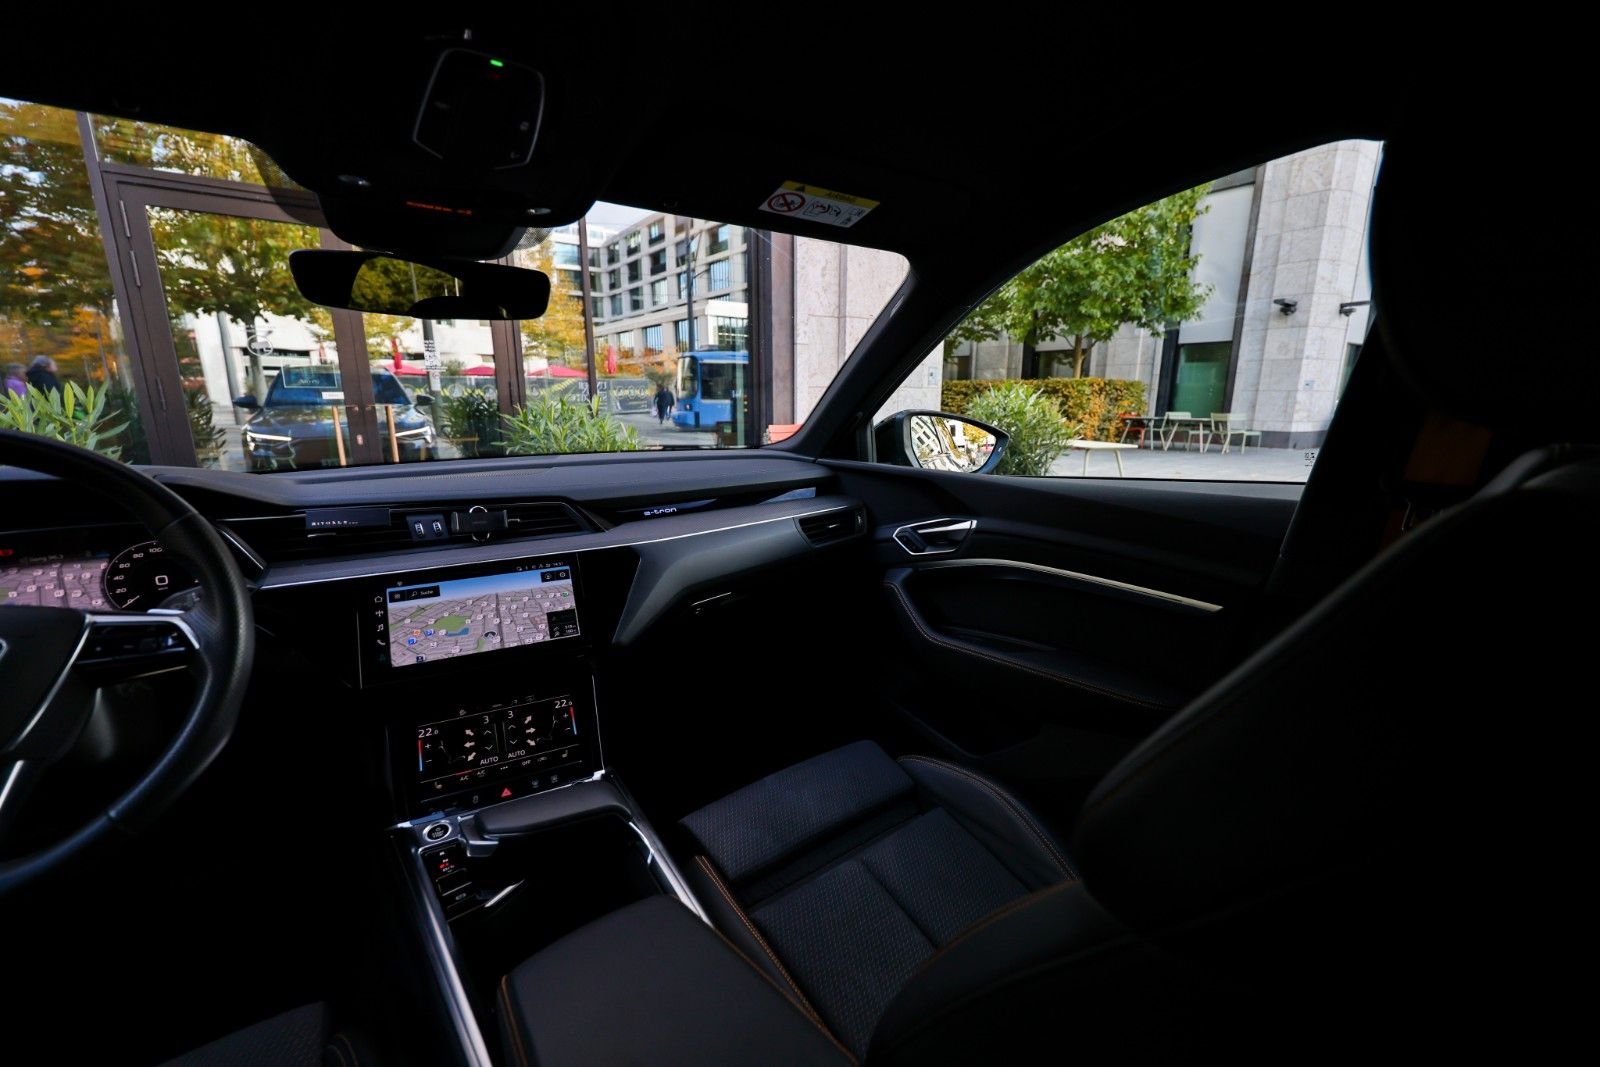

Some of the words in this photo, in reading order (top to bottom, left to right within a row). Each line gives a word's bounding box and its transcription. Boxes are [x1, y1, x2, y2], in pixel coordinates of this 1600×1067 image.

[643, 507, 677, 516] e-tron
[155, 575, 168, 586] 0
[507, 710, 514, 719] 3
[482, 715, 490, 724] 3
[507, 749, 526, 759] AUTO
[479, 756, 499, 766] AUTO
